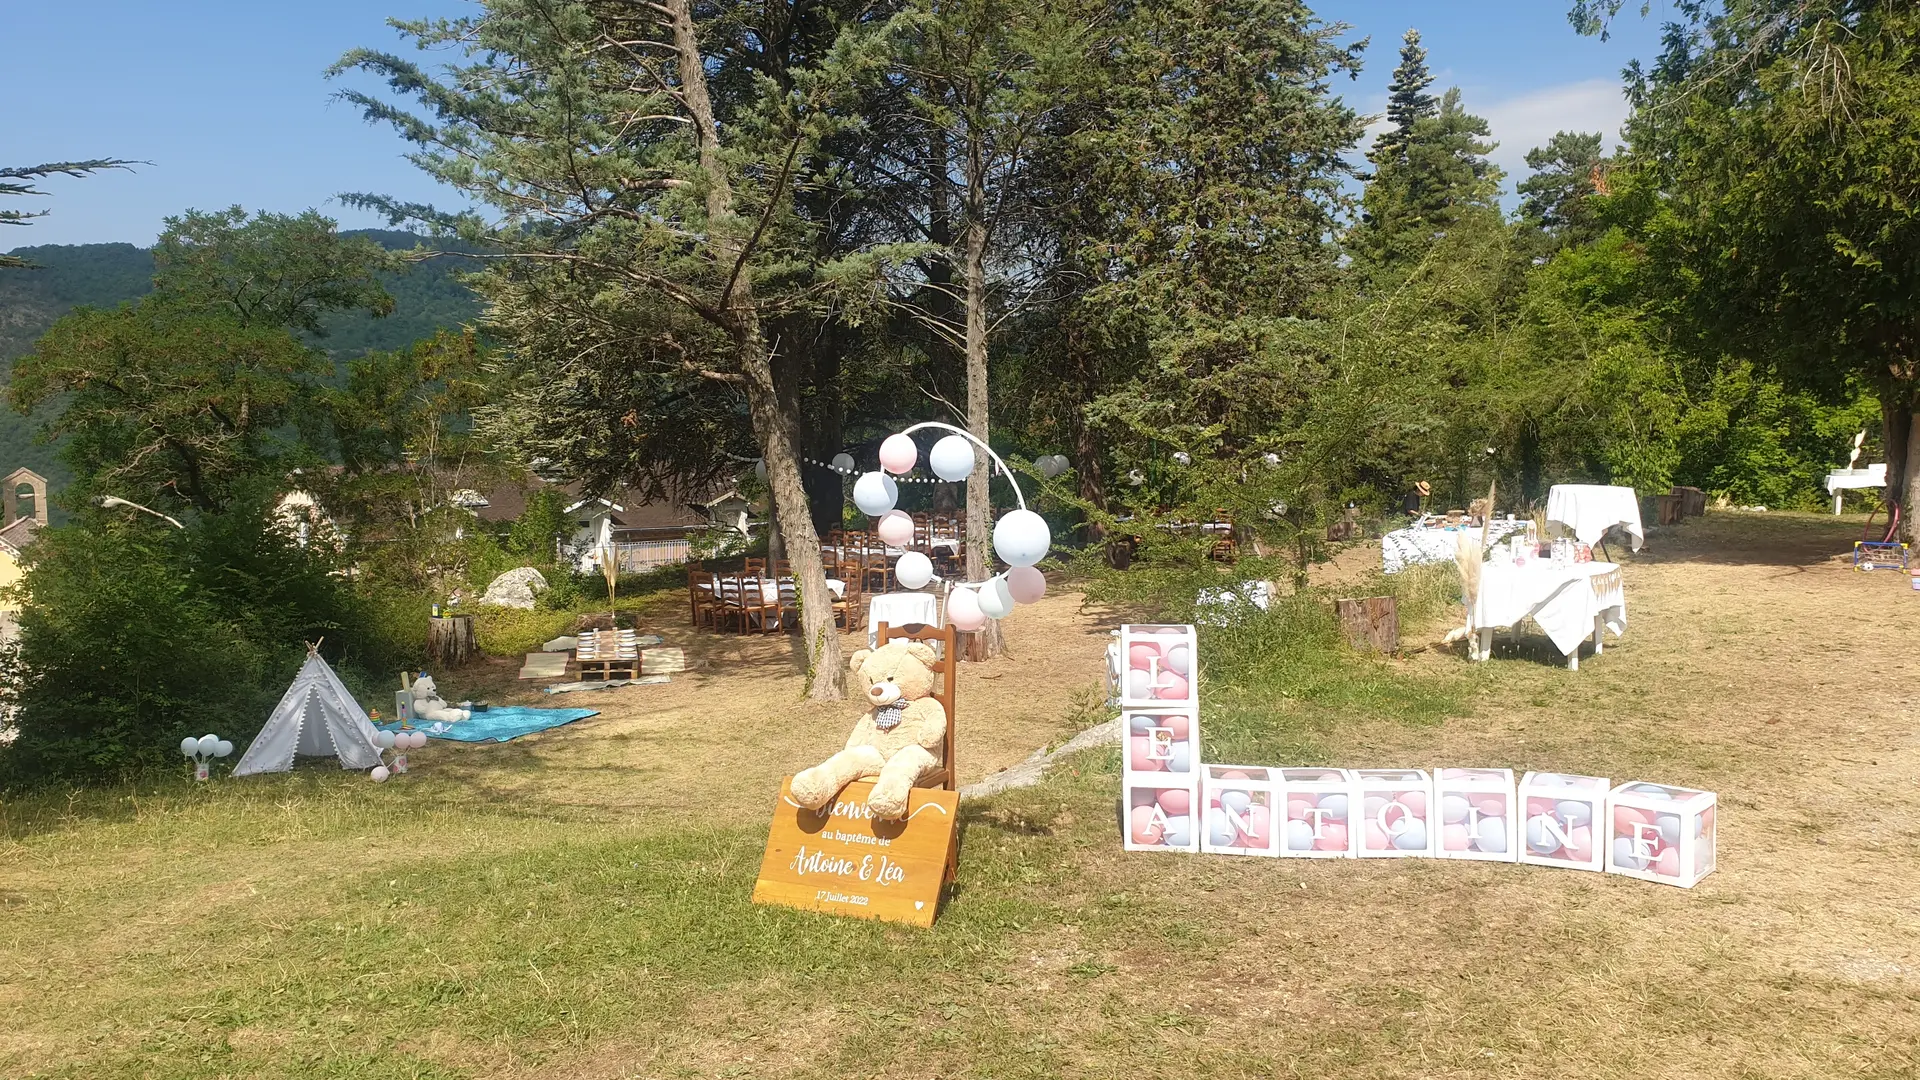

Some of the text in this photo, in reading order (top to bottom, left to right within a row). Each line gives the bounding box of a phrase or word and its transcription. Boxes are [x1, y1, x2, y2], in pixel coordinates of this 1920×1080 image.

[821, 829, 891, 847] au baptême de
[789, 845, 905, 886] Antoine & Léa
[816, 890, 869, 906] 17 Juillet 2022
